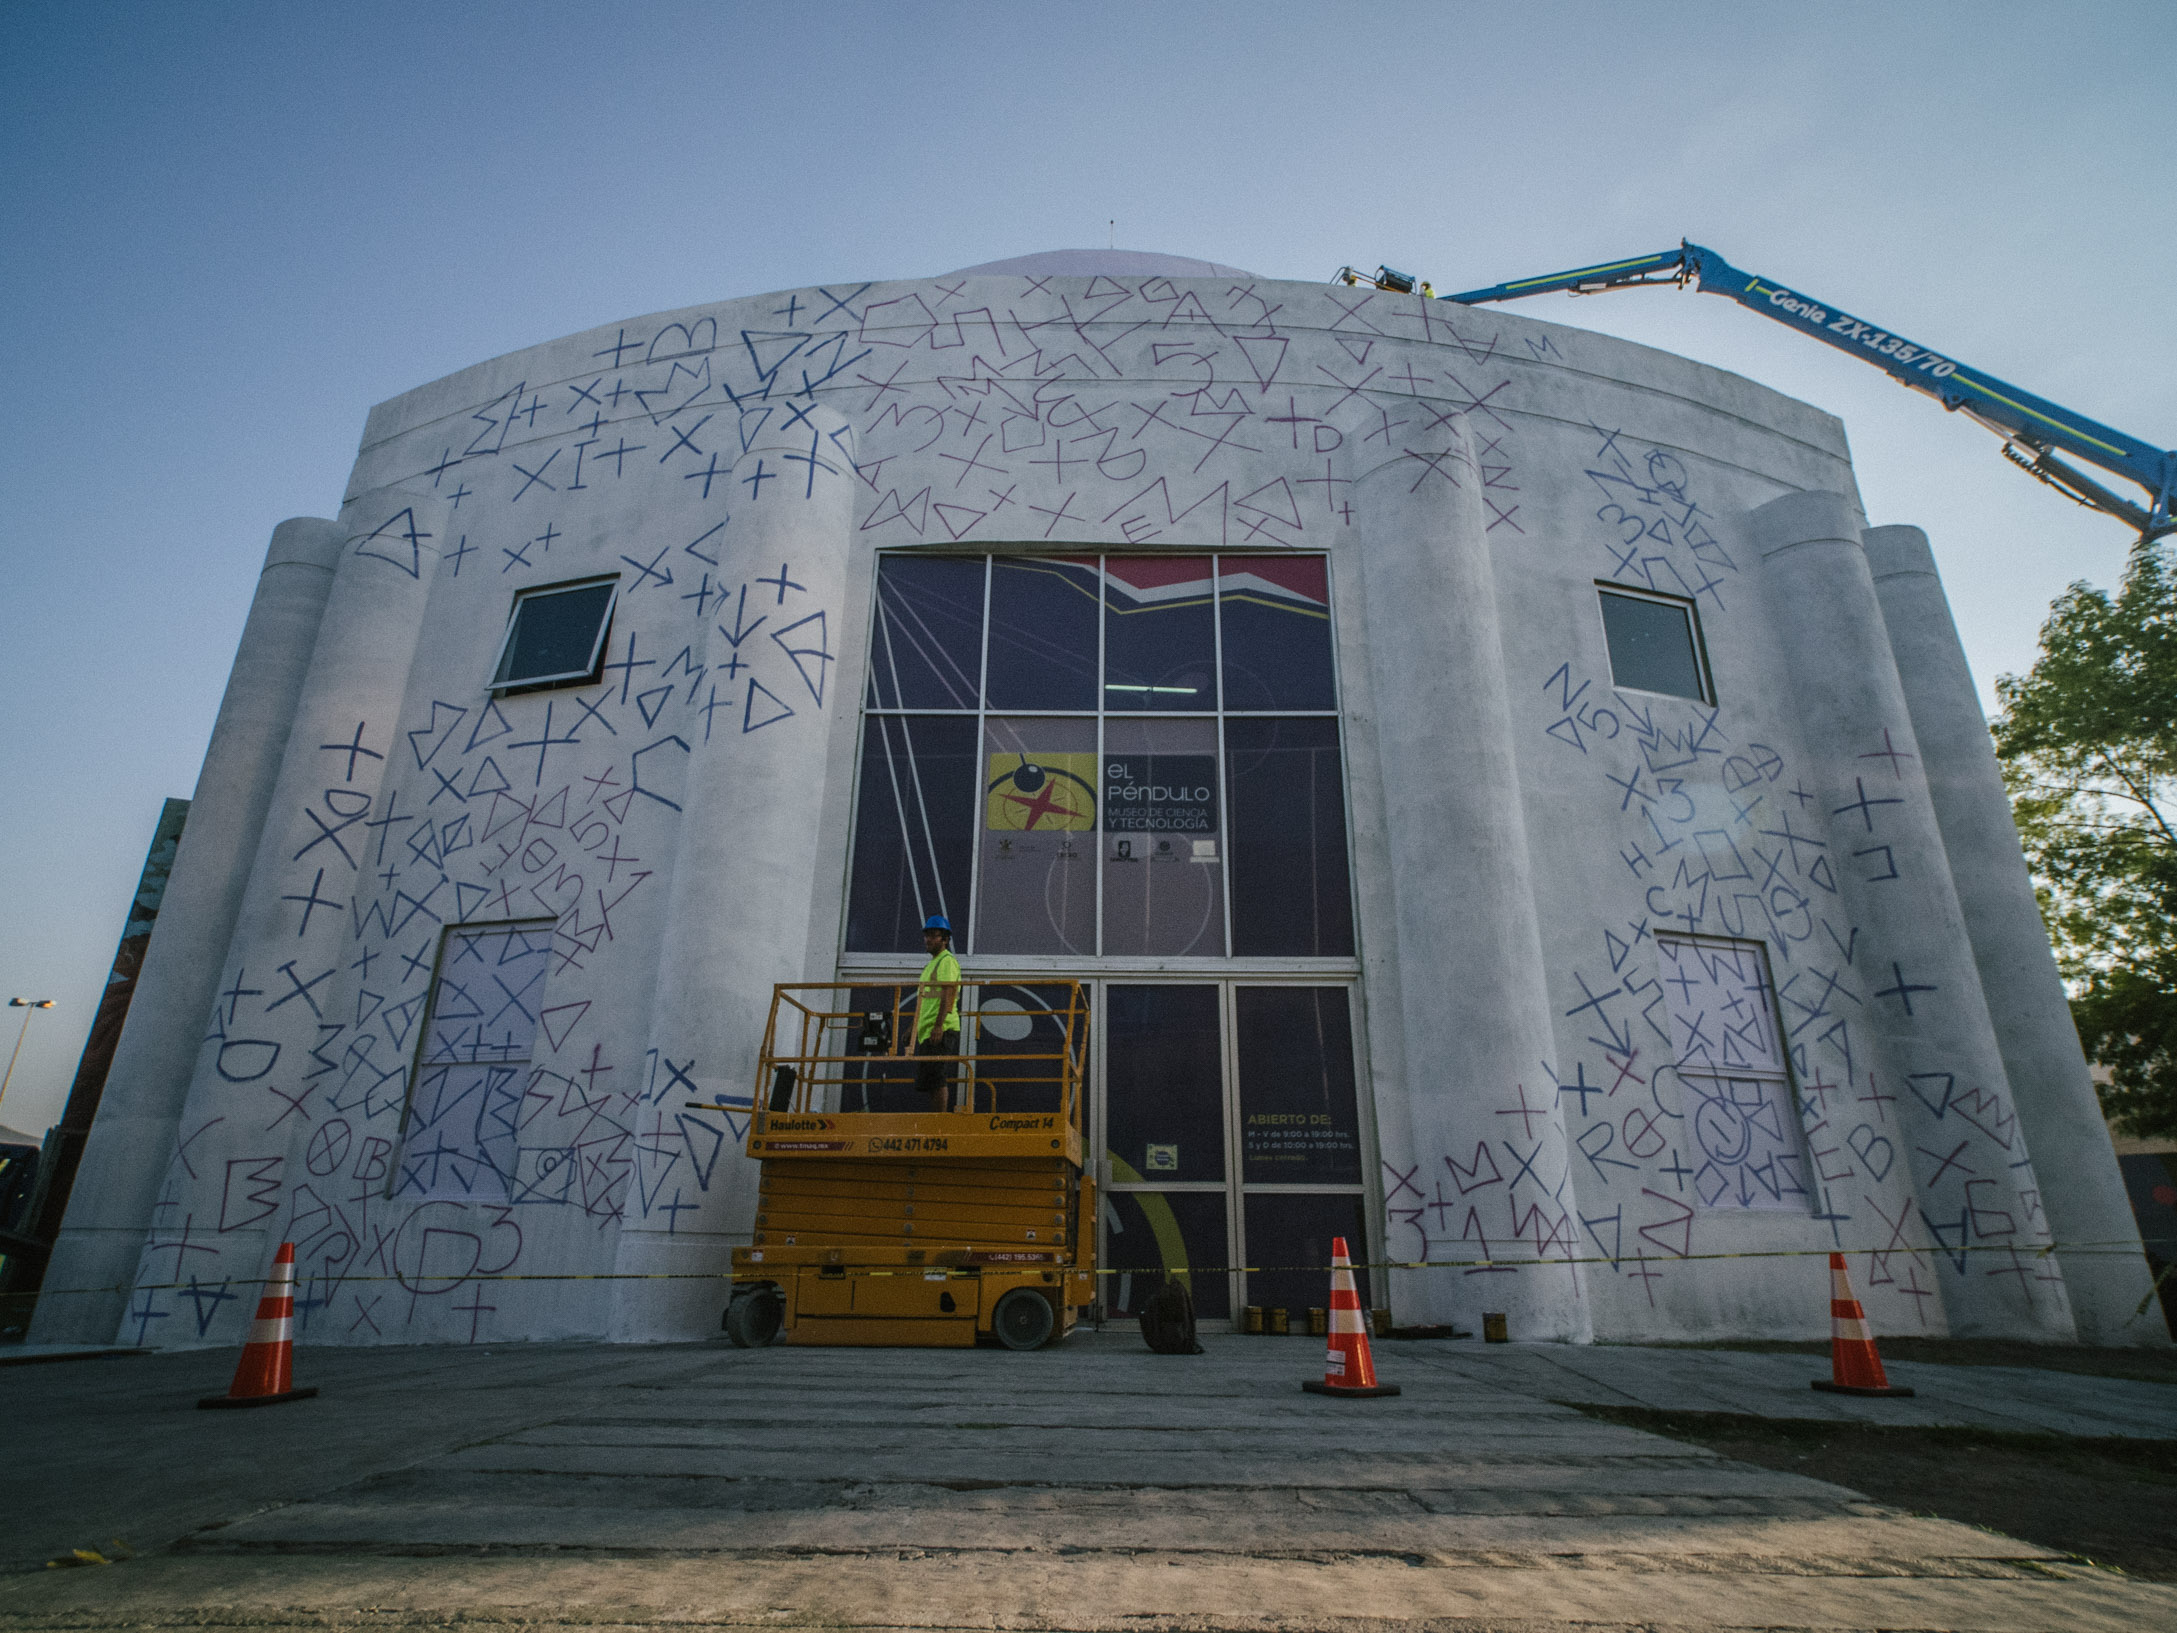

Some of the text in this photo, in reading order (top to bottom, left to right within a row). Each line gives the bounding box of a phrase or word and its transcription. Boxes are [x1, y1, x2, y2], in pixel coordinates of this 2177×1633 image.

[1769, 289, 1956, 377] Genie ZX-135/70
[1108, 808, 1208, 817] MUSEO DE CIENCIA
[1109, 817, 1209, 829] Y TECNOLOGÍA
[770, 1119, 817, 1131] Haulotte
[989, 1115, 1054, 1131] Compact 14
[1248, 1114, 1306, 1124] ABIERTO
[884, 1138, 948, 1151] 442 471 4794
